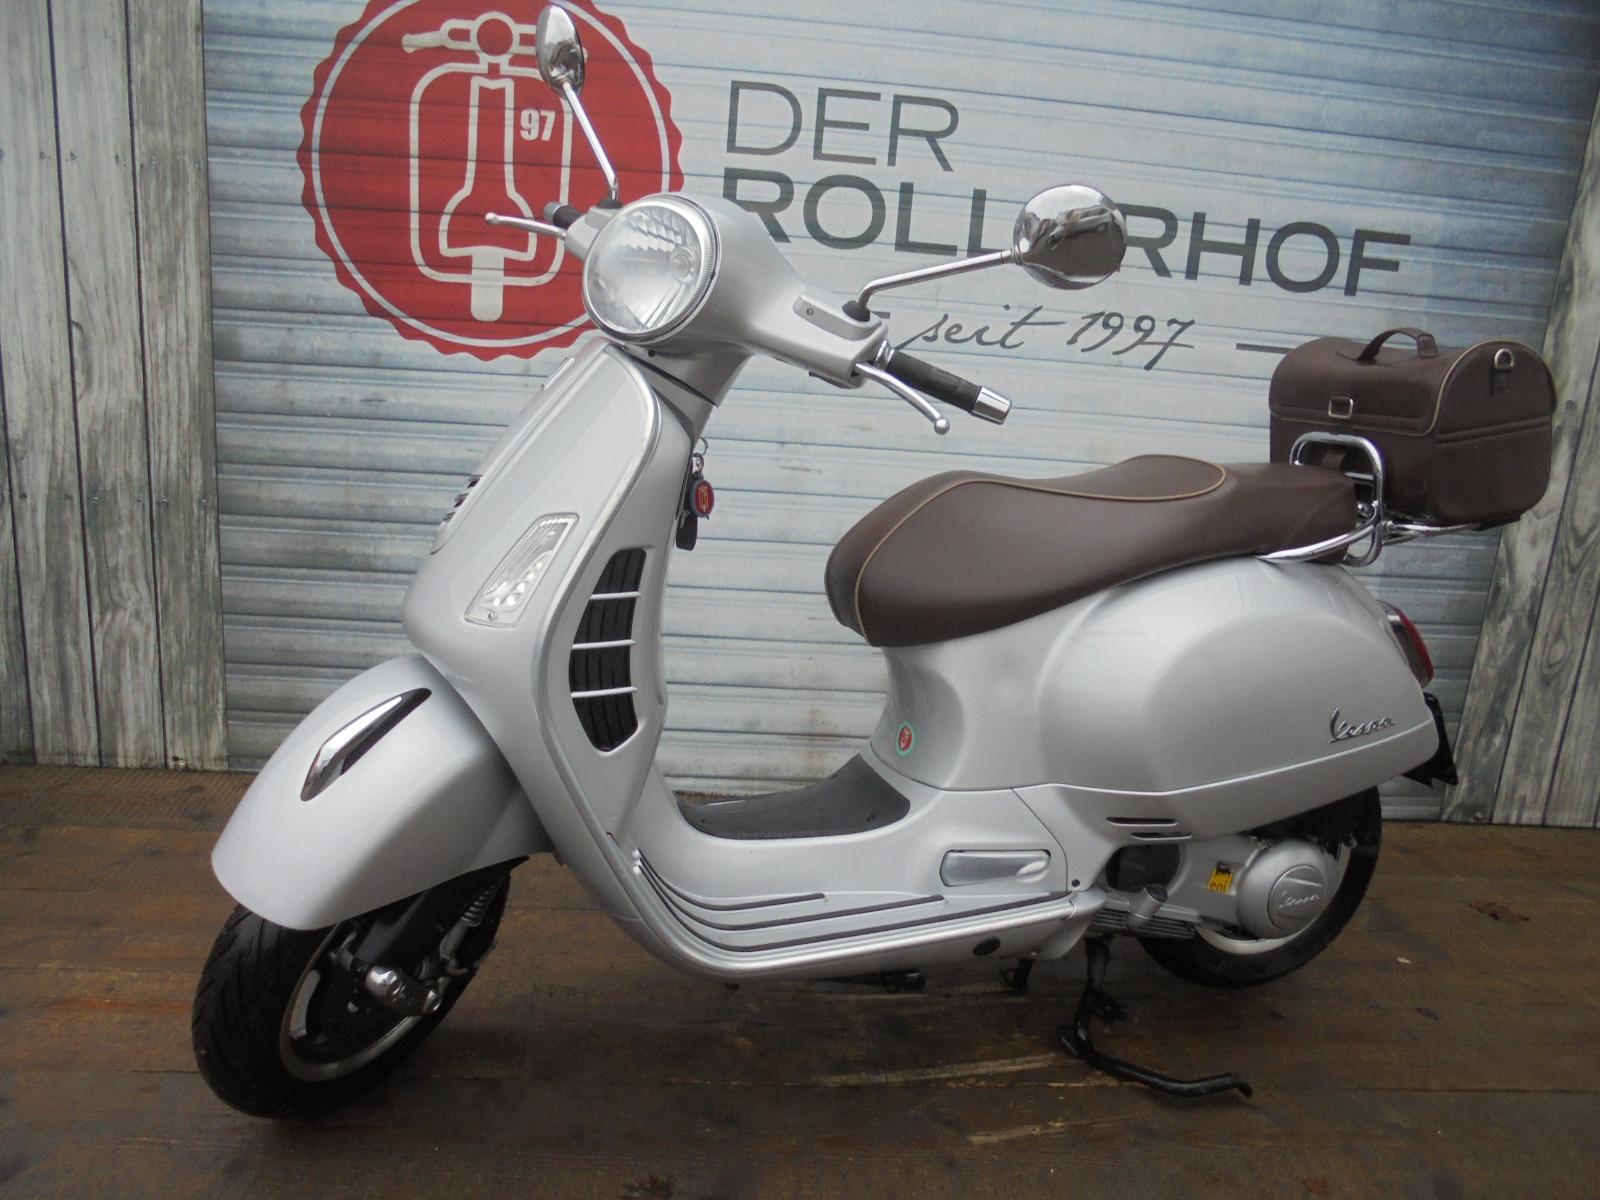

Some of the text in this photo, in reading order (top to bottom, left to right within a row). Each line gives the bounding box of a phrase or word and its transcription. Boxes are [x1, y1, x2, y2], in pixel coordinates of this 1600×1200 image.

[520, 108, 556, 142] 97
[724, 79, 960, 173] DER
[722, 167, 1412, 298] ROLLRHOF
[893, 304, 1197, 371] seit 1997
[1327, 706, 1395, 744] Vespa
